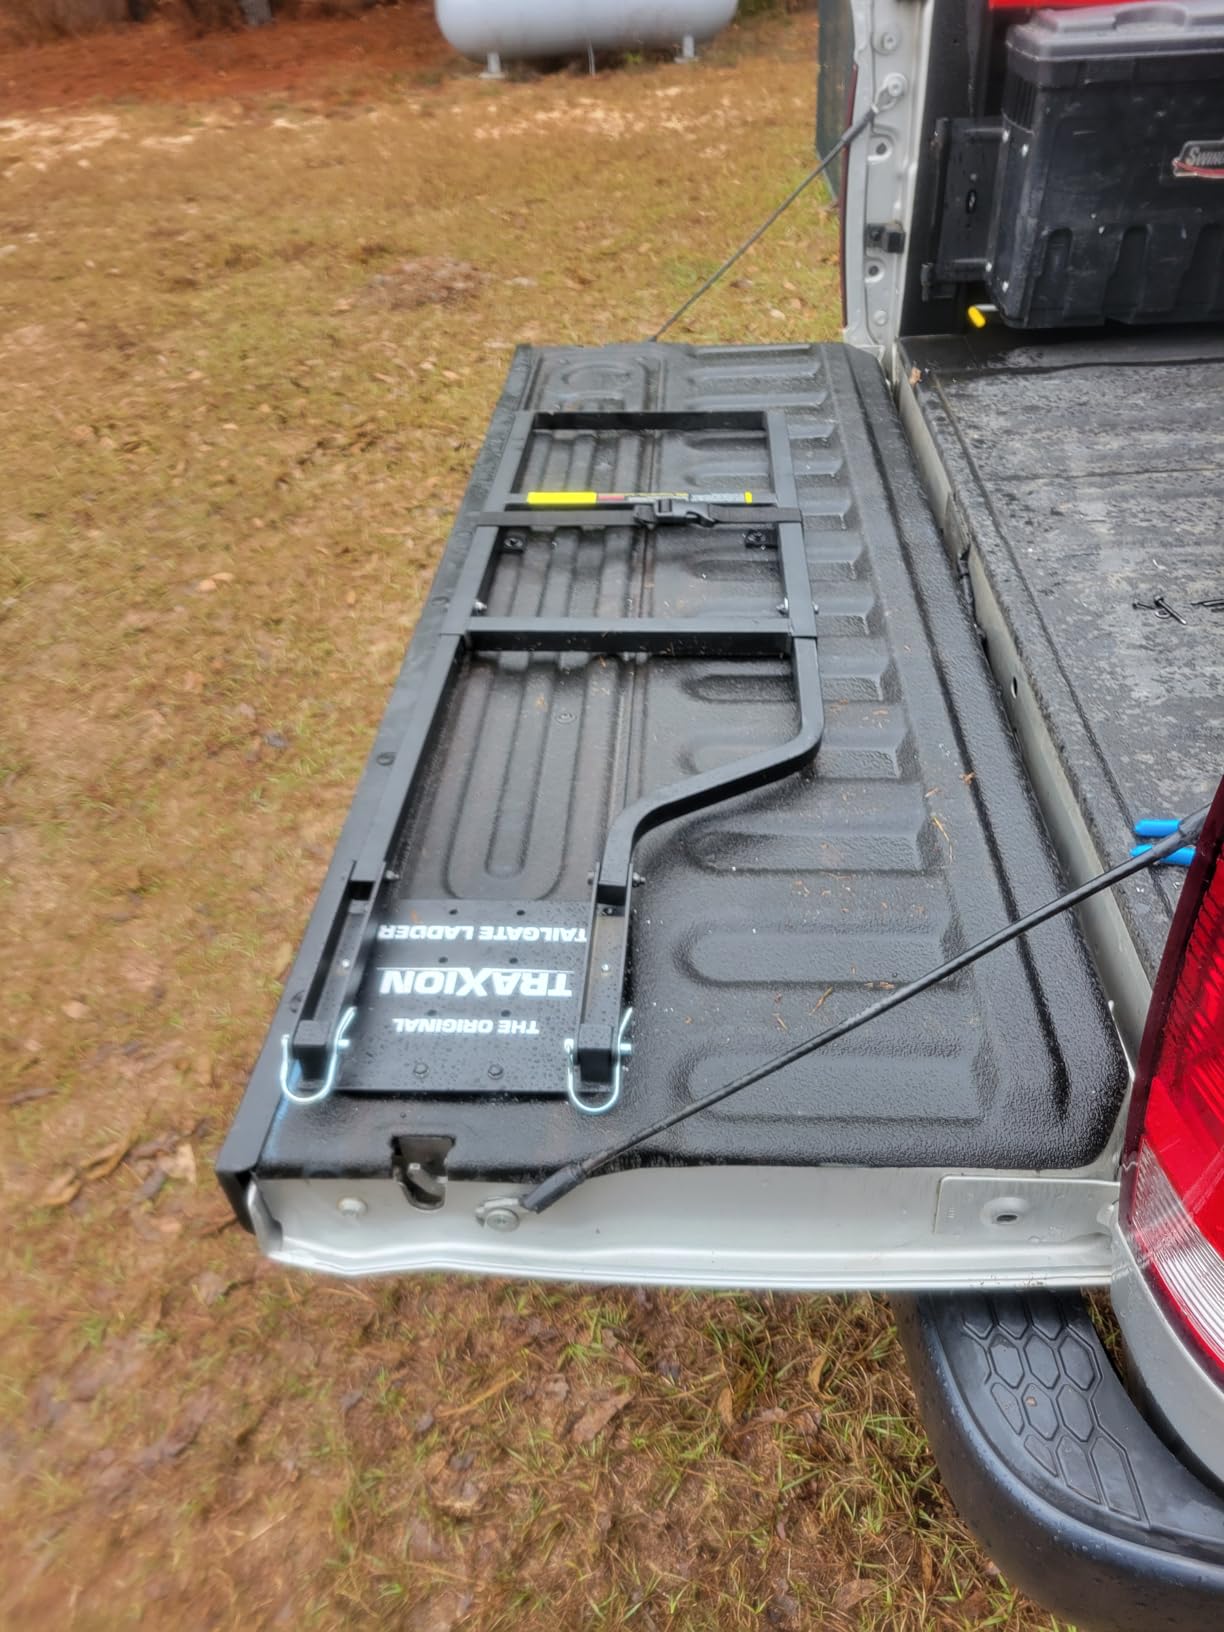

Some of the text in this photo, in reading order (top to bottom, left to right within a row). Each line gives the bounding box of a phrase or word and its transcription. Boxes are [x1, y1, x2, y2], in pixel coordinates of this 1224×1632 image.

[377, 924, 587, 943] TAILGATE LADDER
[380, 968, 572, 997] TRAXION
[393, 1017, 540, 1035] THE ORIGINAL
